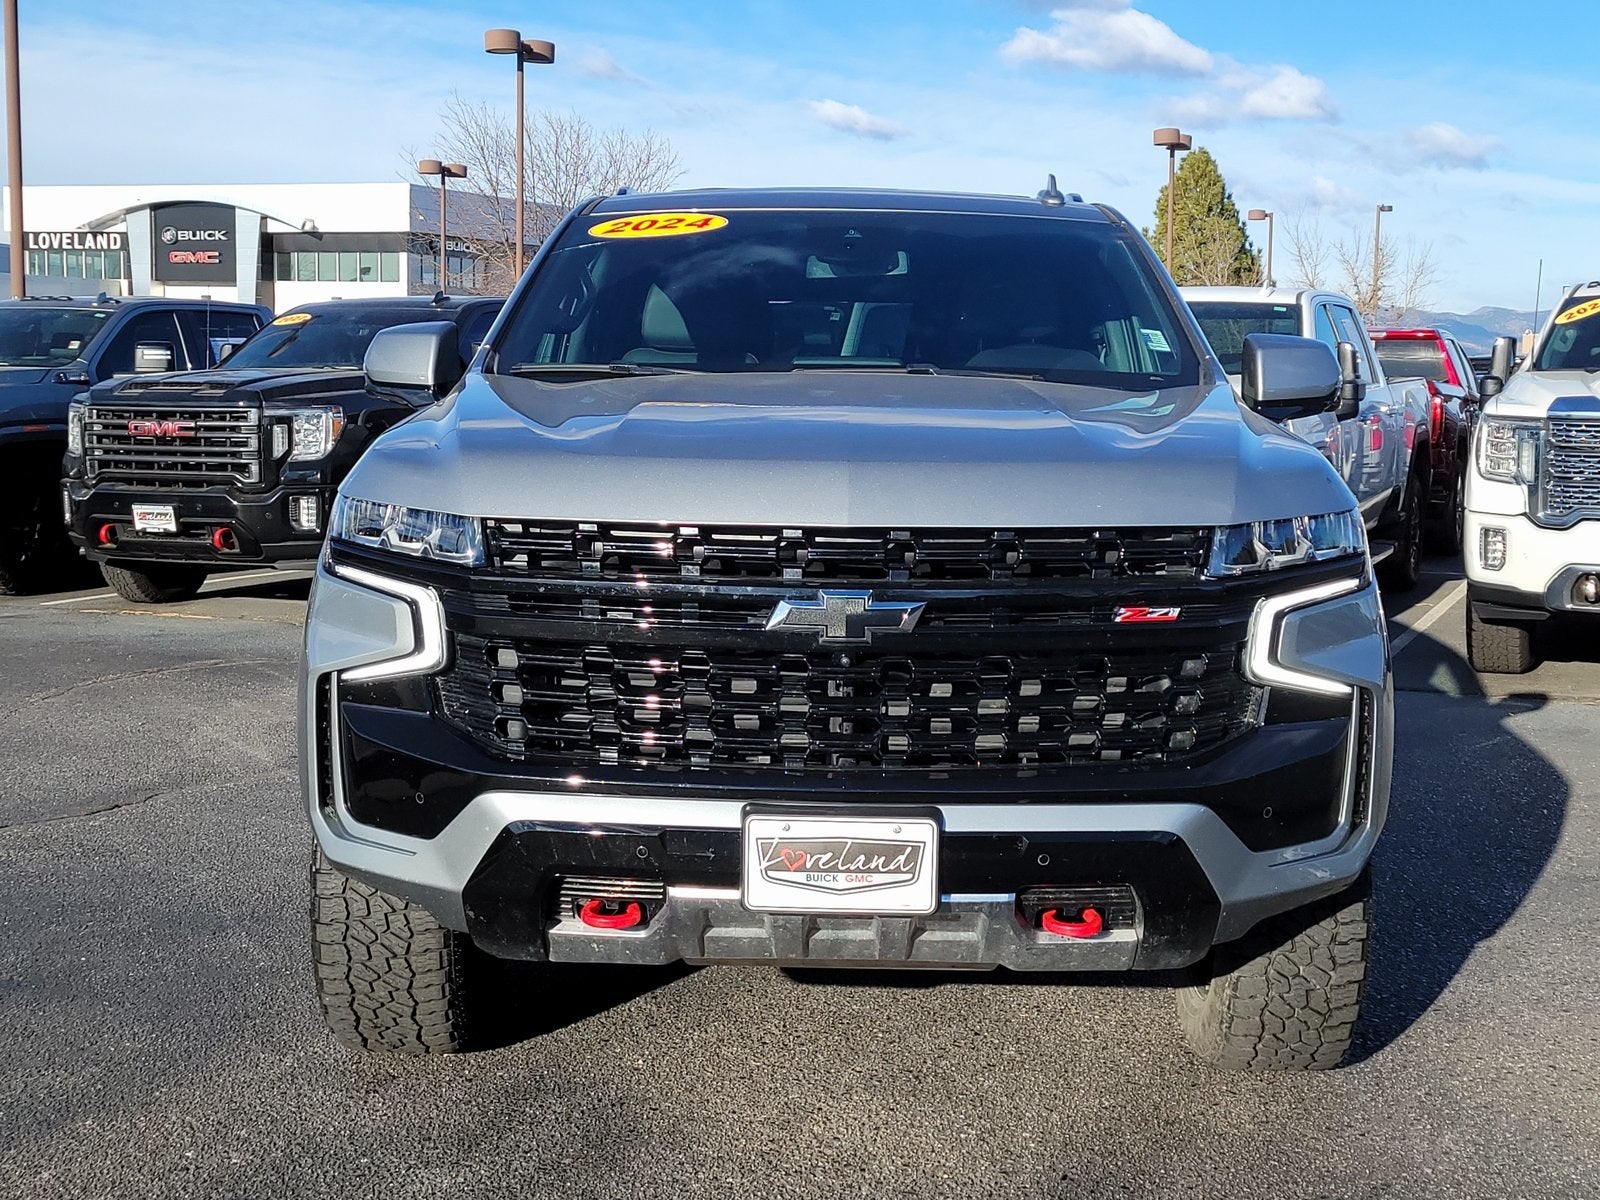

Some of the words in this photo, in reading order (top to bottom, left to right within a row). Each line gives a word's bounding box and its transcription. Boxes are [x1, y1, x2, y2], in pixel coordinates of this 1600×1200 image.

[601, 217, 714, 234] 2024
[29, 233, 121, 249] LOVELAND
[177, 230, 228, 240] BUICK
[169, 251, 219, 263] GMC
[1564, 302, 1600, 320] 202
[128, 420, 196, 437] GMC
[1114, 607, 1180, 622] Z71
[805, 873, 839, 883] BUICK
[844, 874, 873, 883] GMC
